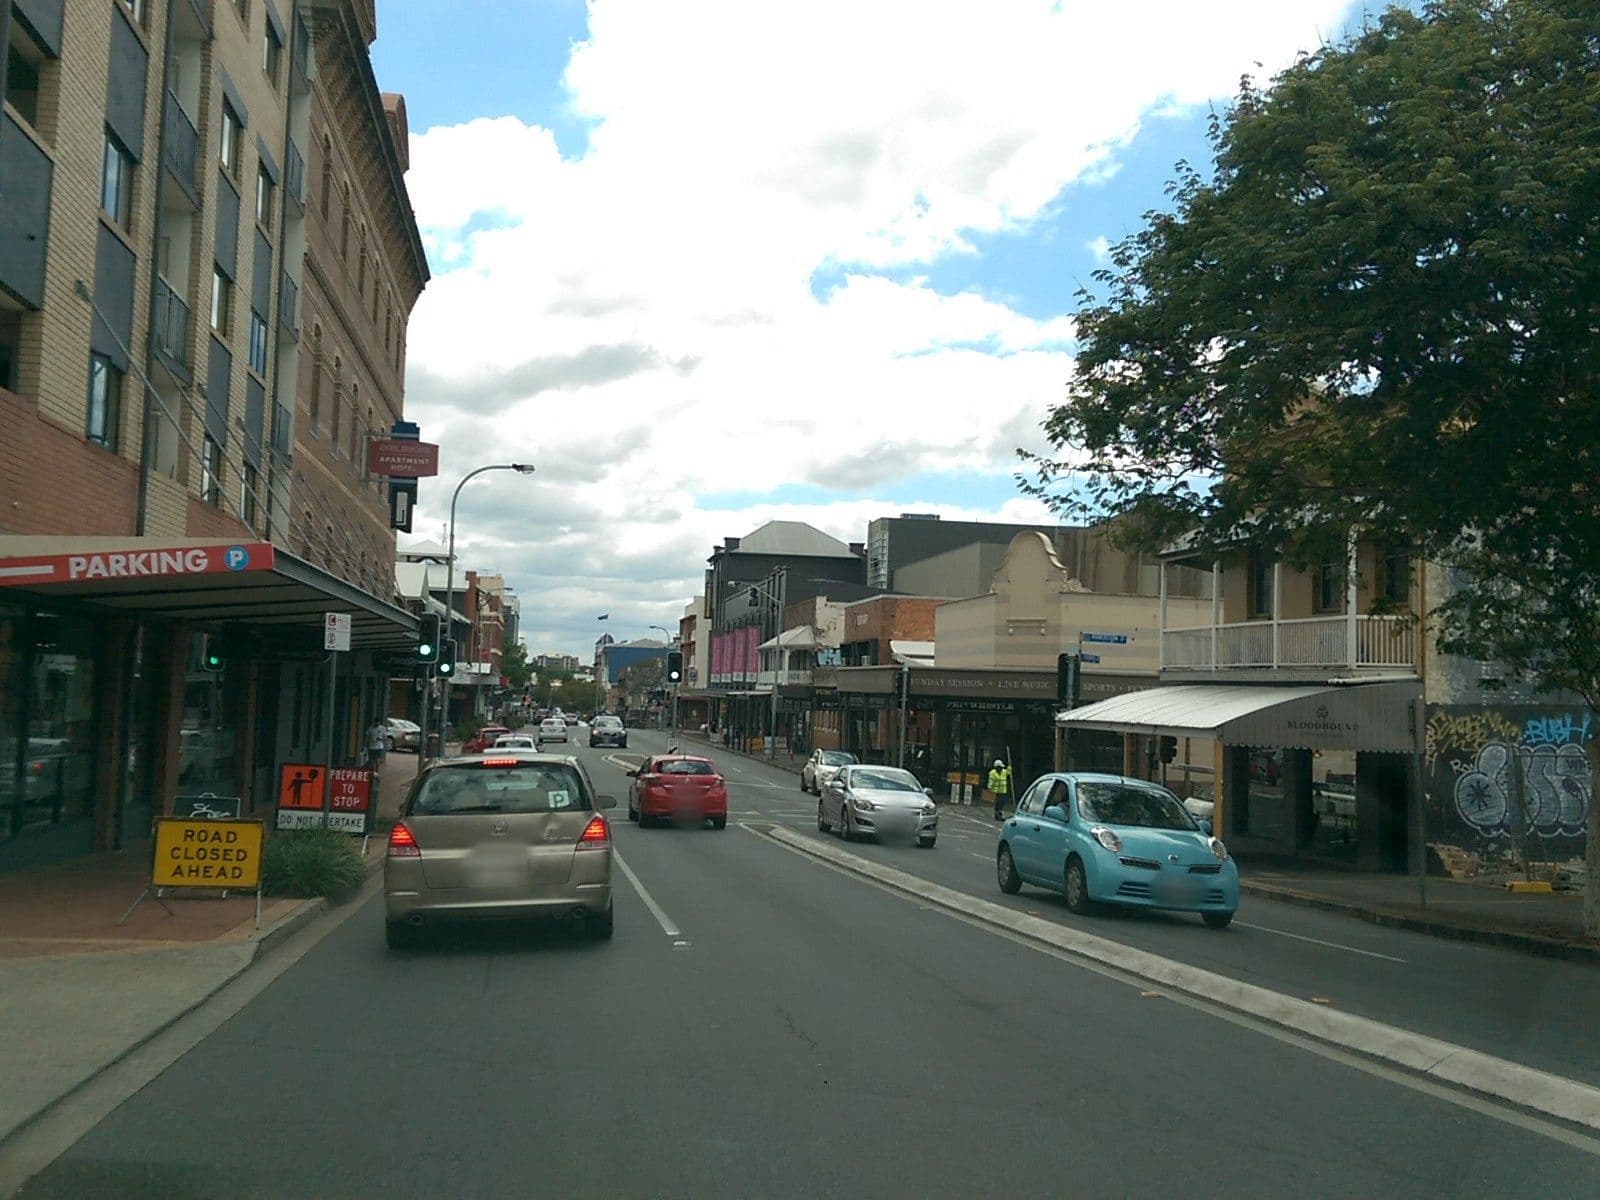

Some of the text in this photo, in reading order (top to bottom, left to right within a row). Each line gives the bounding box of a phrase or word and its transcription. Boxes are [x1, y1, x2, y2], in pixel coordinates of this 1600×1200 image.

[380, 456, 430, 465] APARTMENT
[391, 464, 416, 472] HOTEL
[68, 549, 244, 579] PARKING P
[998, 680, 1019, 688] LIVE
[1287, 720, 1360, 731] BLOODHOUND
[329, 769, 369, 782] PREPARE
[342, 783, 355, 794] TO
[334, 796, 360, 807] STOP
[279, 814, 292, 824] DO
[296, 816, 313, 826] NOT
[183, 829, 238, 844] ROAD
[170, 847, 248, 862] CLOSED
[171, 865, 243, 879] AHEAD
